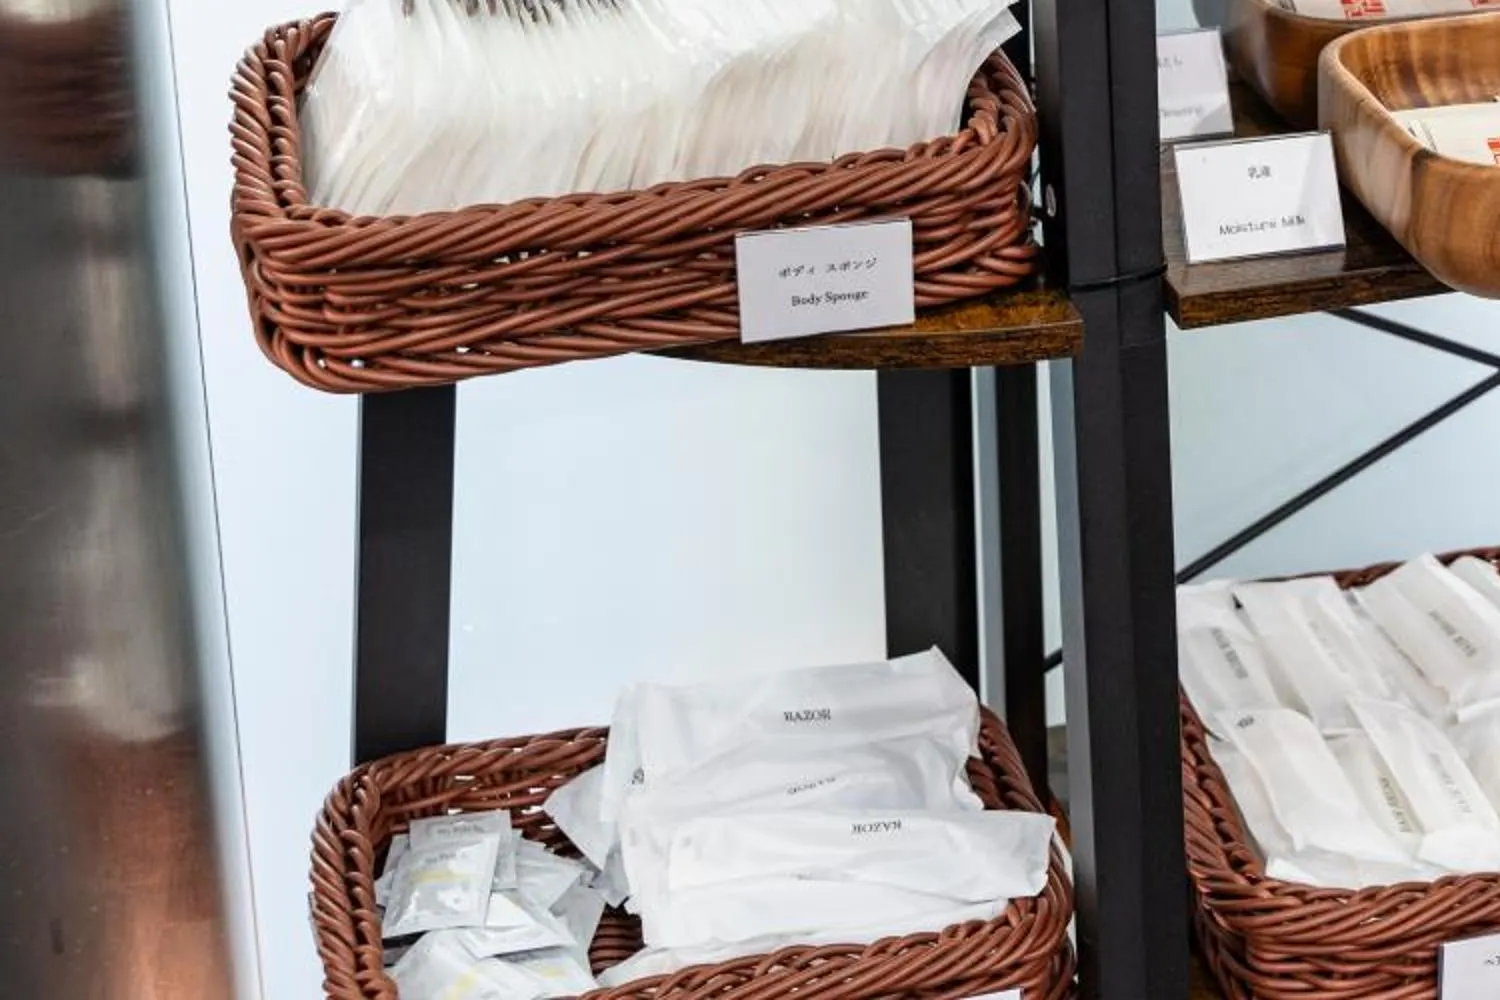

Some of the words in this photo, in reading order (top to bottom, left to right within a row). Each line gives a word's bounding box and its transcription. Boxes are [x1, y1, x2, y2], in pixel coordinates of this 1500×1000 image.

[791, 292, 823, 307] Body
[824, 290, 869, 305] Sponge
[783, 708, 832, 723] RAZOR
